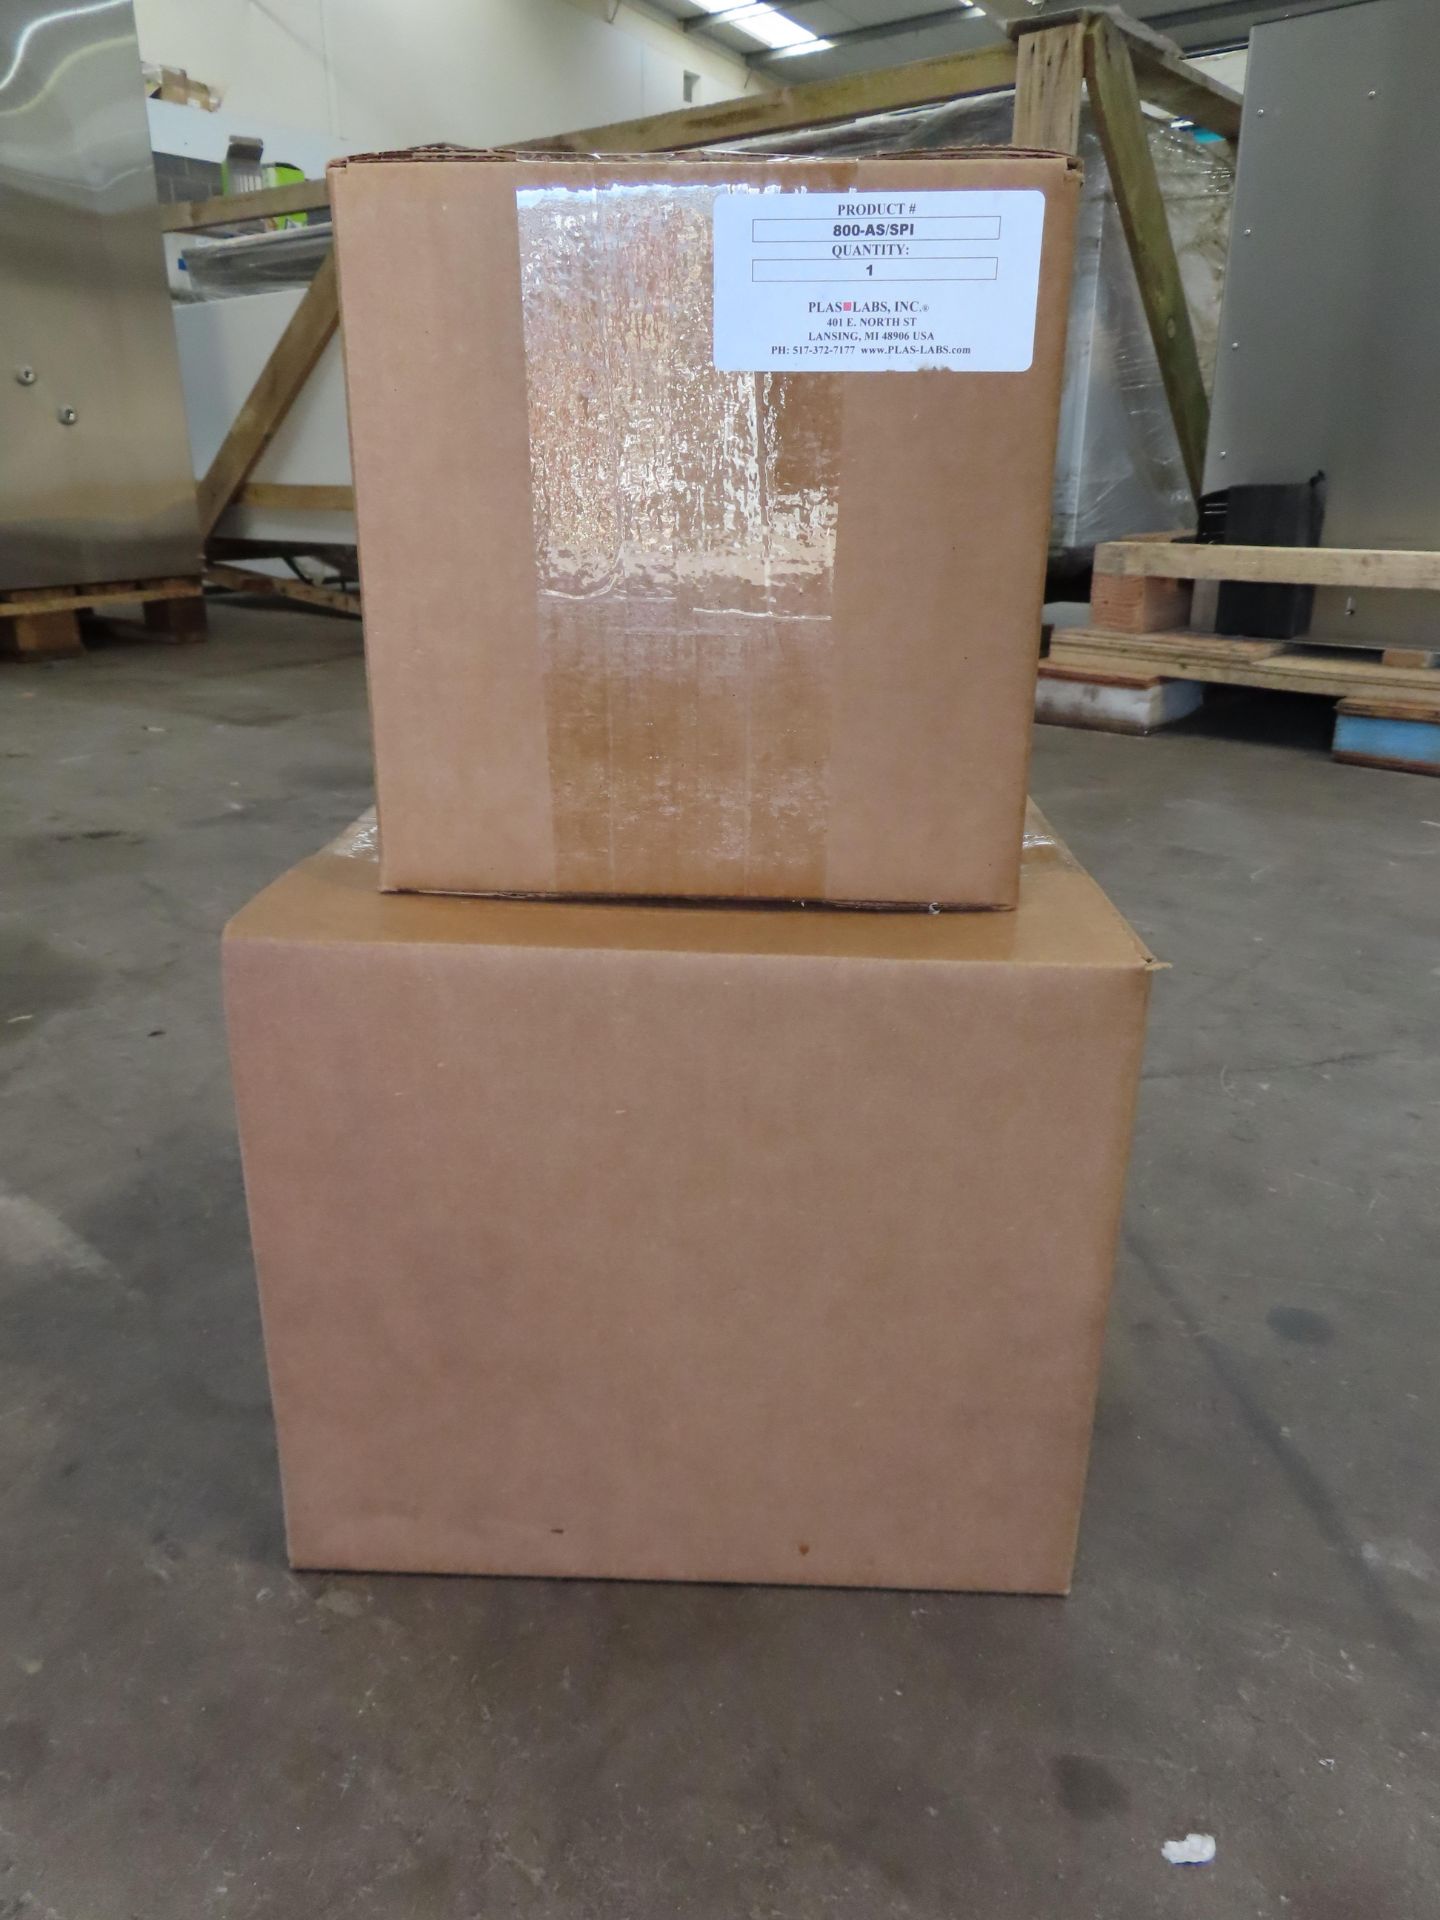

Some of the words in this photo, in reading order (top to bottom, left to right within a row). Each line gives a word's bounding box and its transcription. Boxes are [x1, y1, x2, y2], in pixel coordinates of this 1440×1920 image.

[838, 203, 905, 216] PRODUCT
[909, 203, 916, 214] #
[833, 223, 914, 237] 800-AS/SPI
[832, 244, 909, 258] QUANTITY:
[866, 264, 873, 276] 1
[827, 318, 842, 327] 401
[847, 318, 856, 327] E.
[860, 317, 900, 327] NORTH
[903, 317, 917, 326] ST
[808, 332, 861, 342] LANSING,
[864, 332, 879, 340] MI
[882, 332, 909, 340] 48906
[913, 331, 934, 340] USA
[772, 346, 789, 354] PH:
[793, 346, 855, 354] 517-372-7177
[861, 345, 971, 354] www.PLAS-LABS.com
